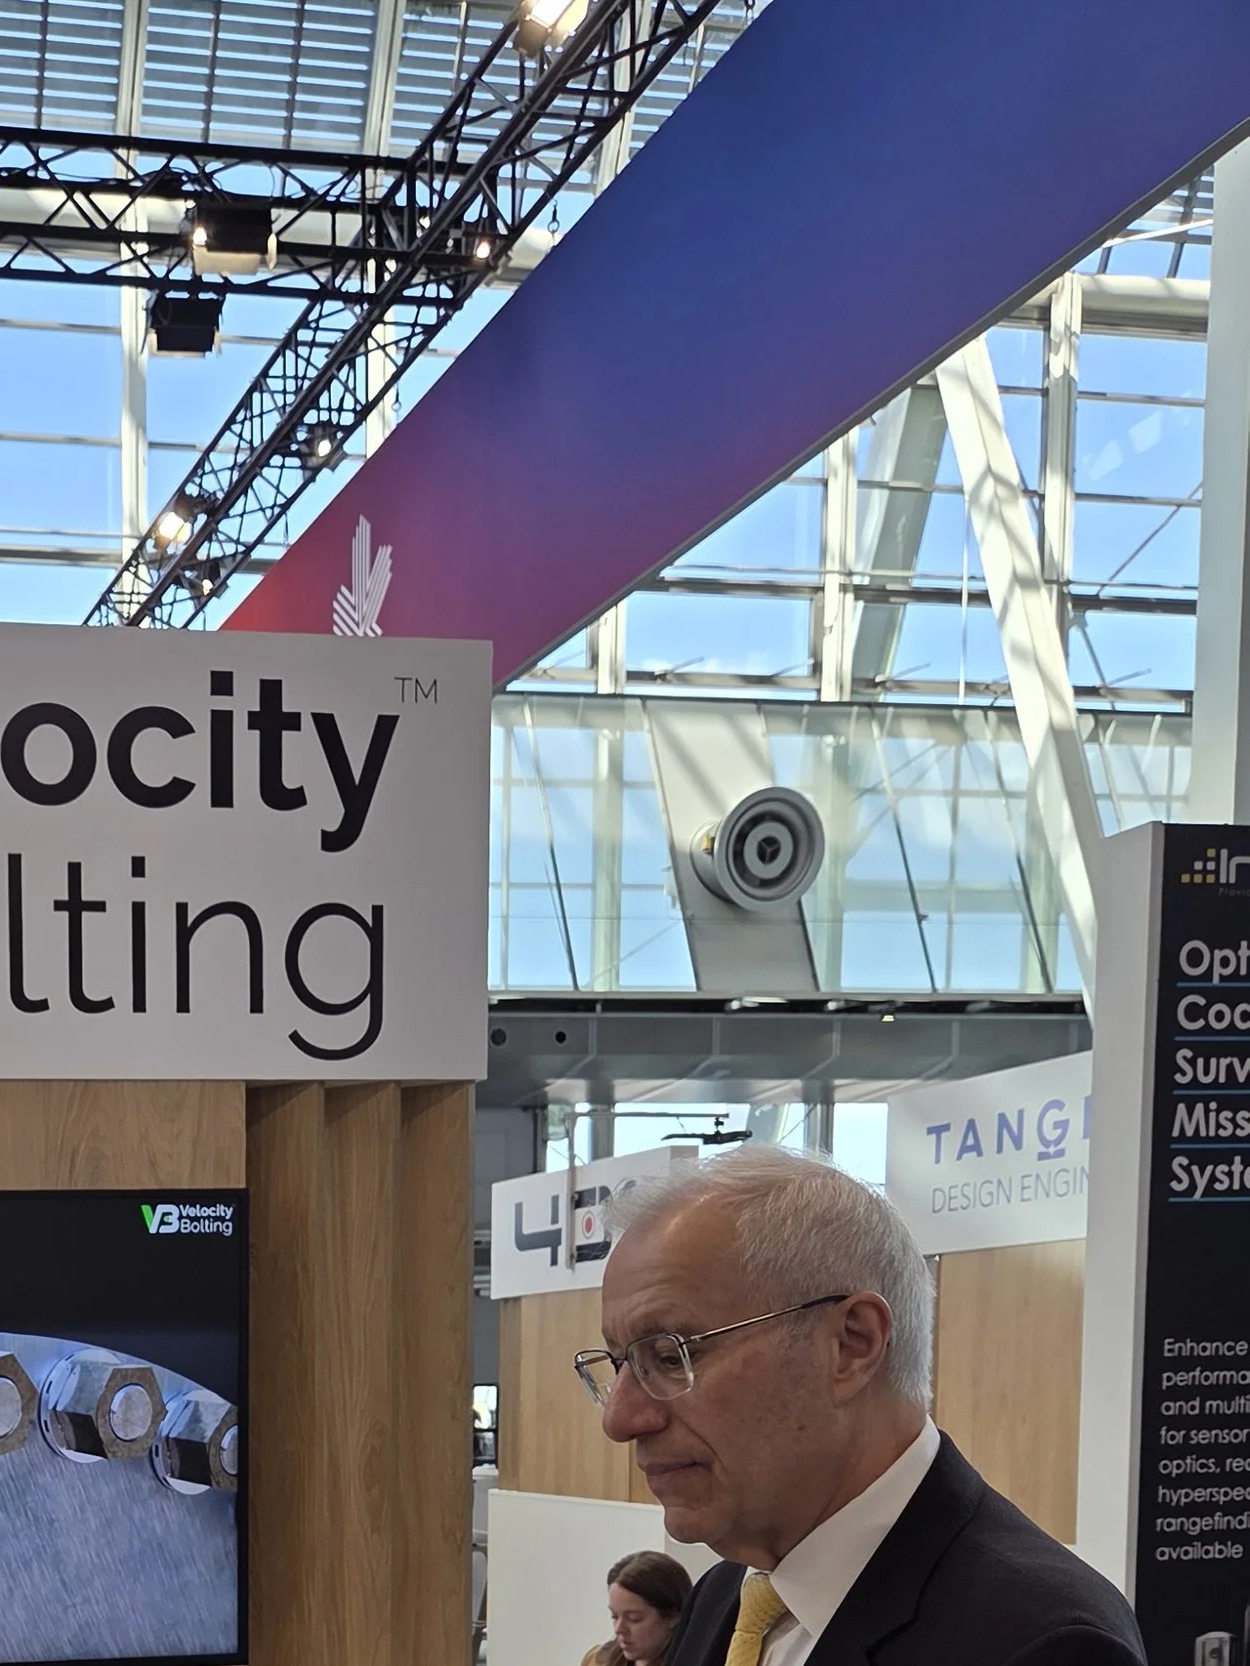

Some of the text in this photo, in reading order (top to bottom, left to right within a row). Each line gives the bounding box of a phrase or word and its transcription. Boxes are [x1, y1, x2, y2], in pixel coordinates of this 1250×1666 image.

[1179, 939, 1250, 985] Opt
[1177, 994, 1250, 1030] Coc
[1173, 1048, 1250, 1084] Surv
[1171, 1101, 1250, 1138] Miss
[931, 1176, 1013, 1214] DESIGN
[179, 1204, 233, 1219] Velocity
[180, 1218, 233, 1236] Bolting
[1163, 1338, 1249, 1356] Enhance
[1160, 1396, 1200, 1415] and
[1160, 1426, 1186, 1445] for
[1158, 1454, 1221, 1478] optics,
[1155, 1541, 1244, 1561] available
